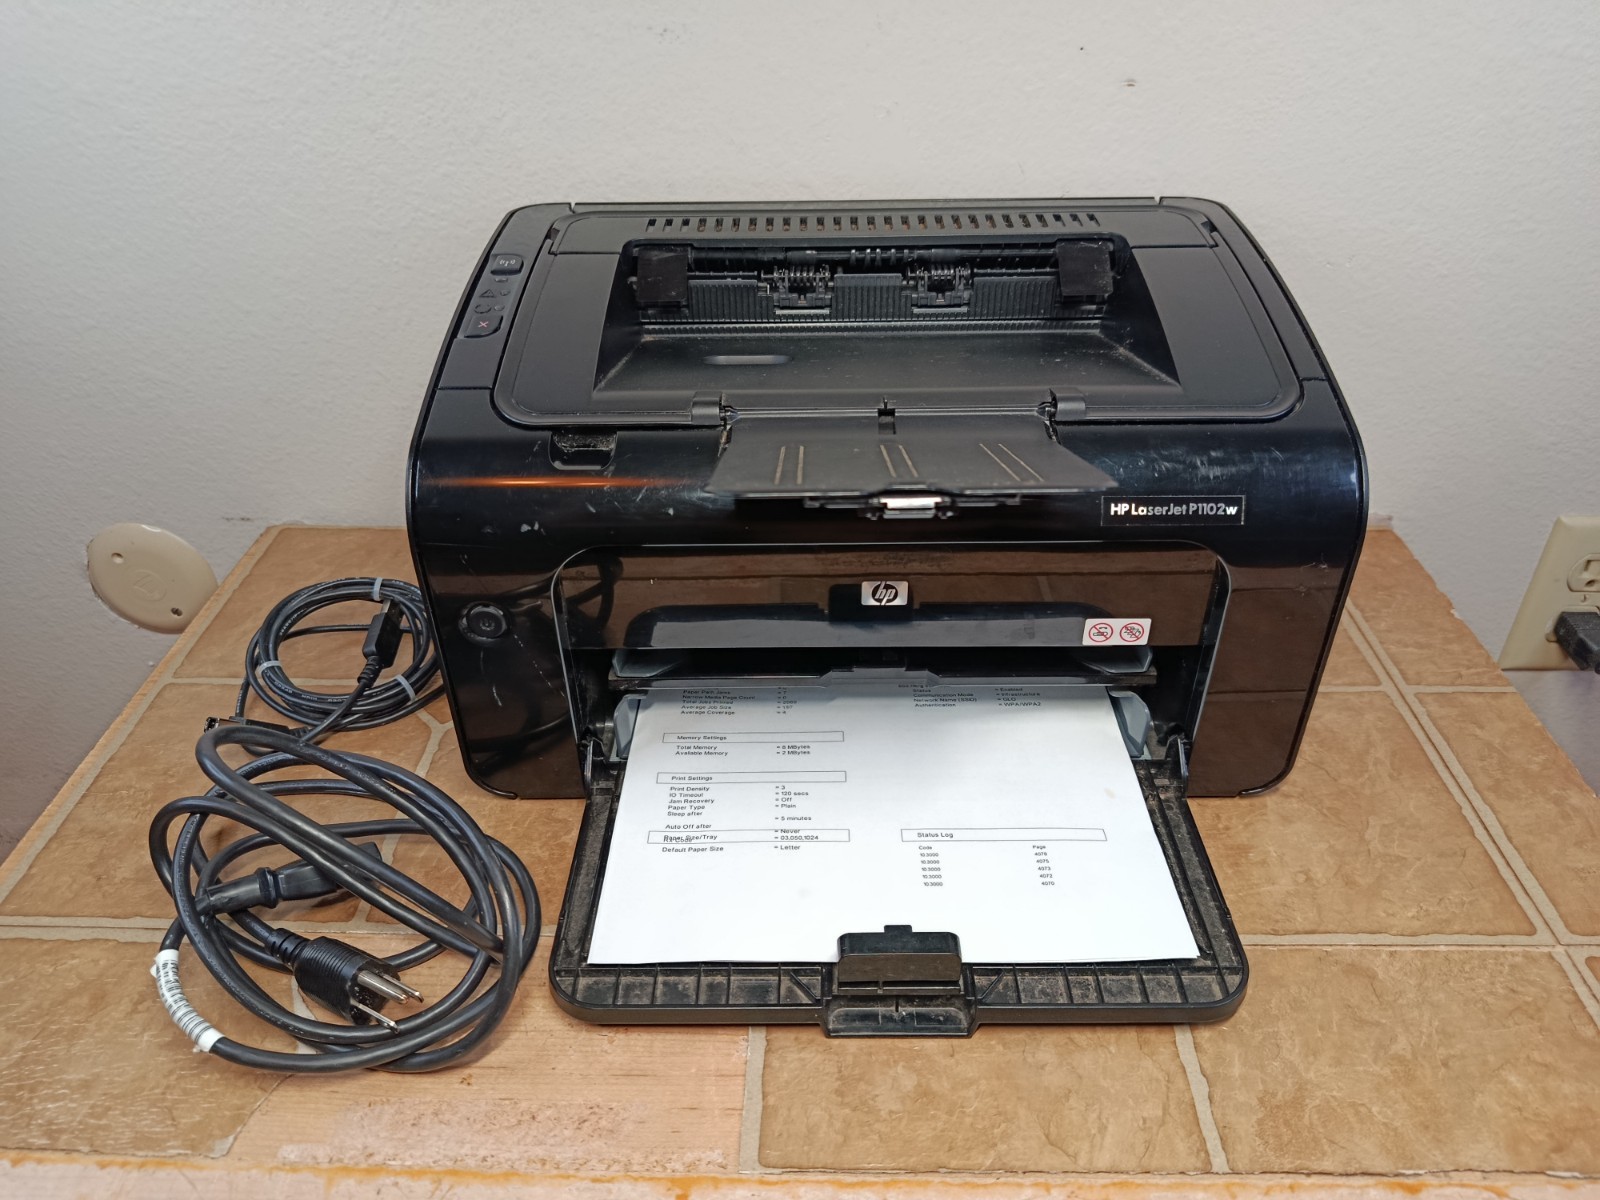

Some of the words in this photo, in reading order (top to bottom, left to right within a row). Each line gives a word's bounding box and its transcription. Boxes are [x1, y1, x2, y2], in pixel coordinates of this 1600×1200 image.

[1110, 503, 1130, 516] HP
[1131, 503, 1187, 516] LaserJet
[1189, 503, 1238, 516] P1102w
[874, 581, 896, 605] hp
